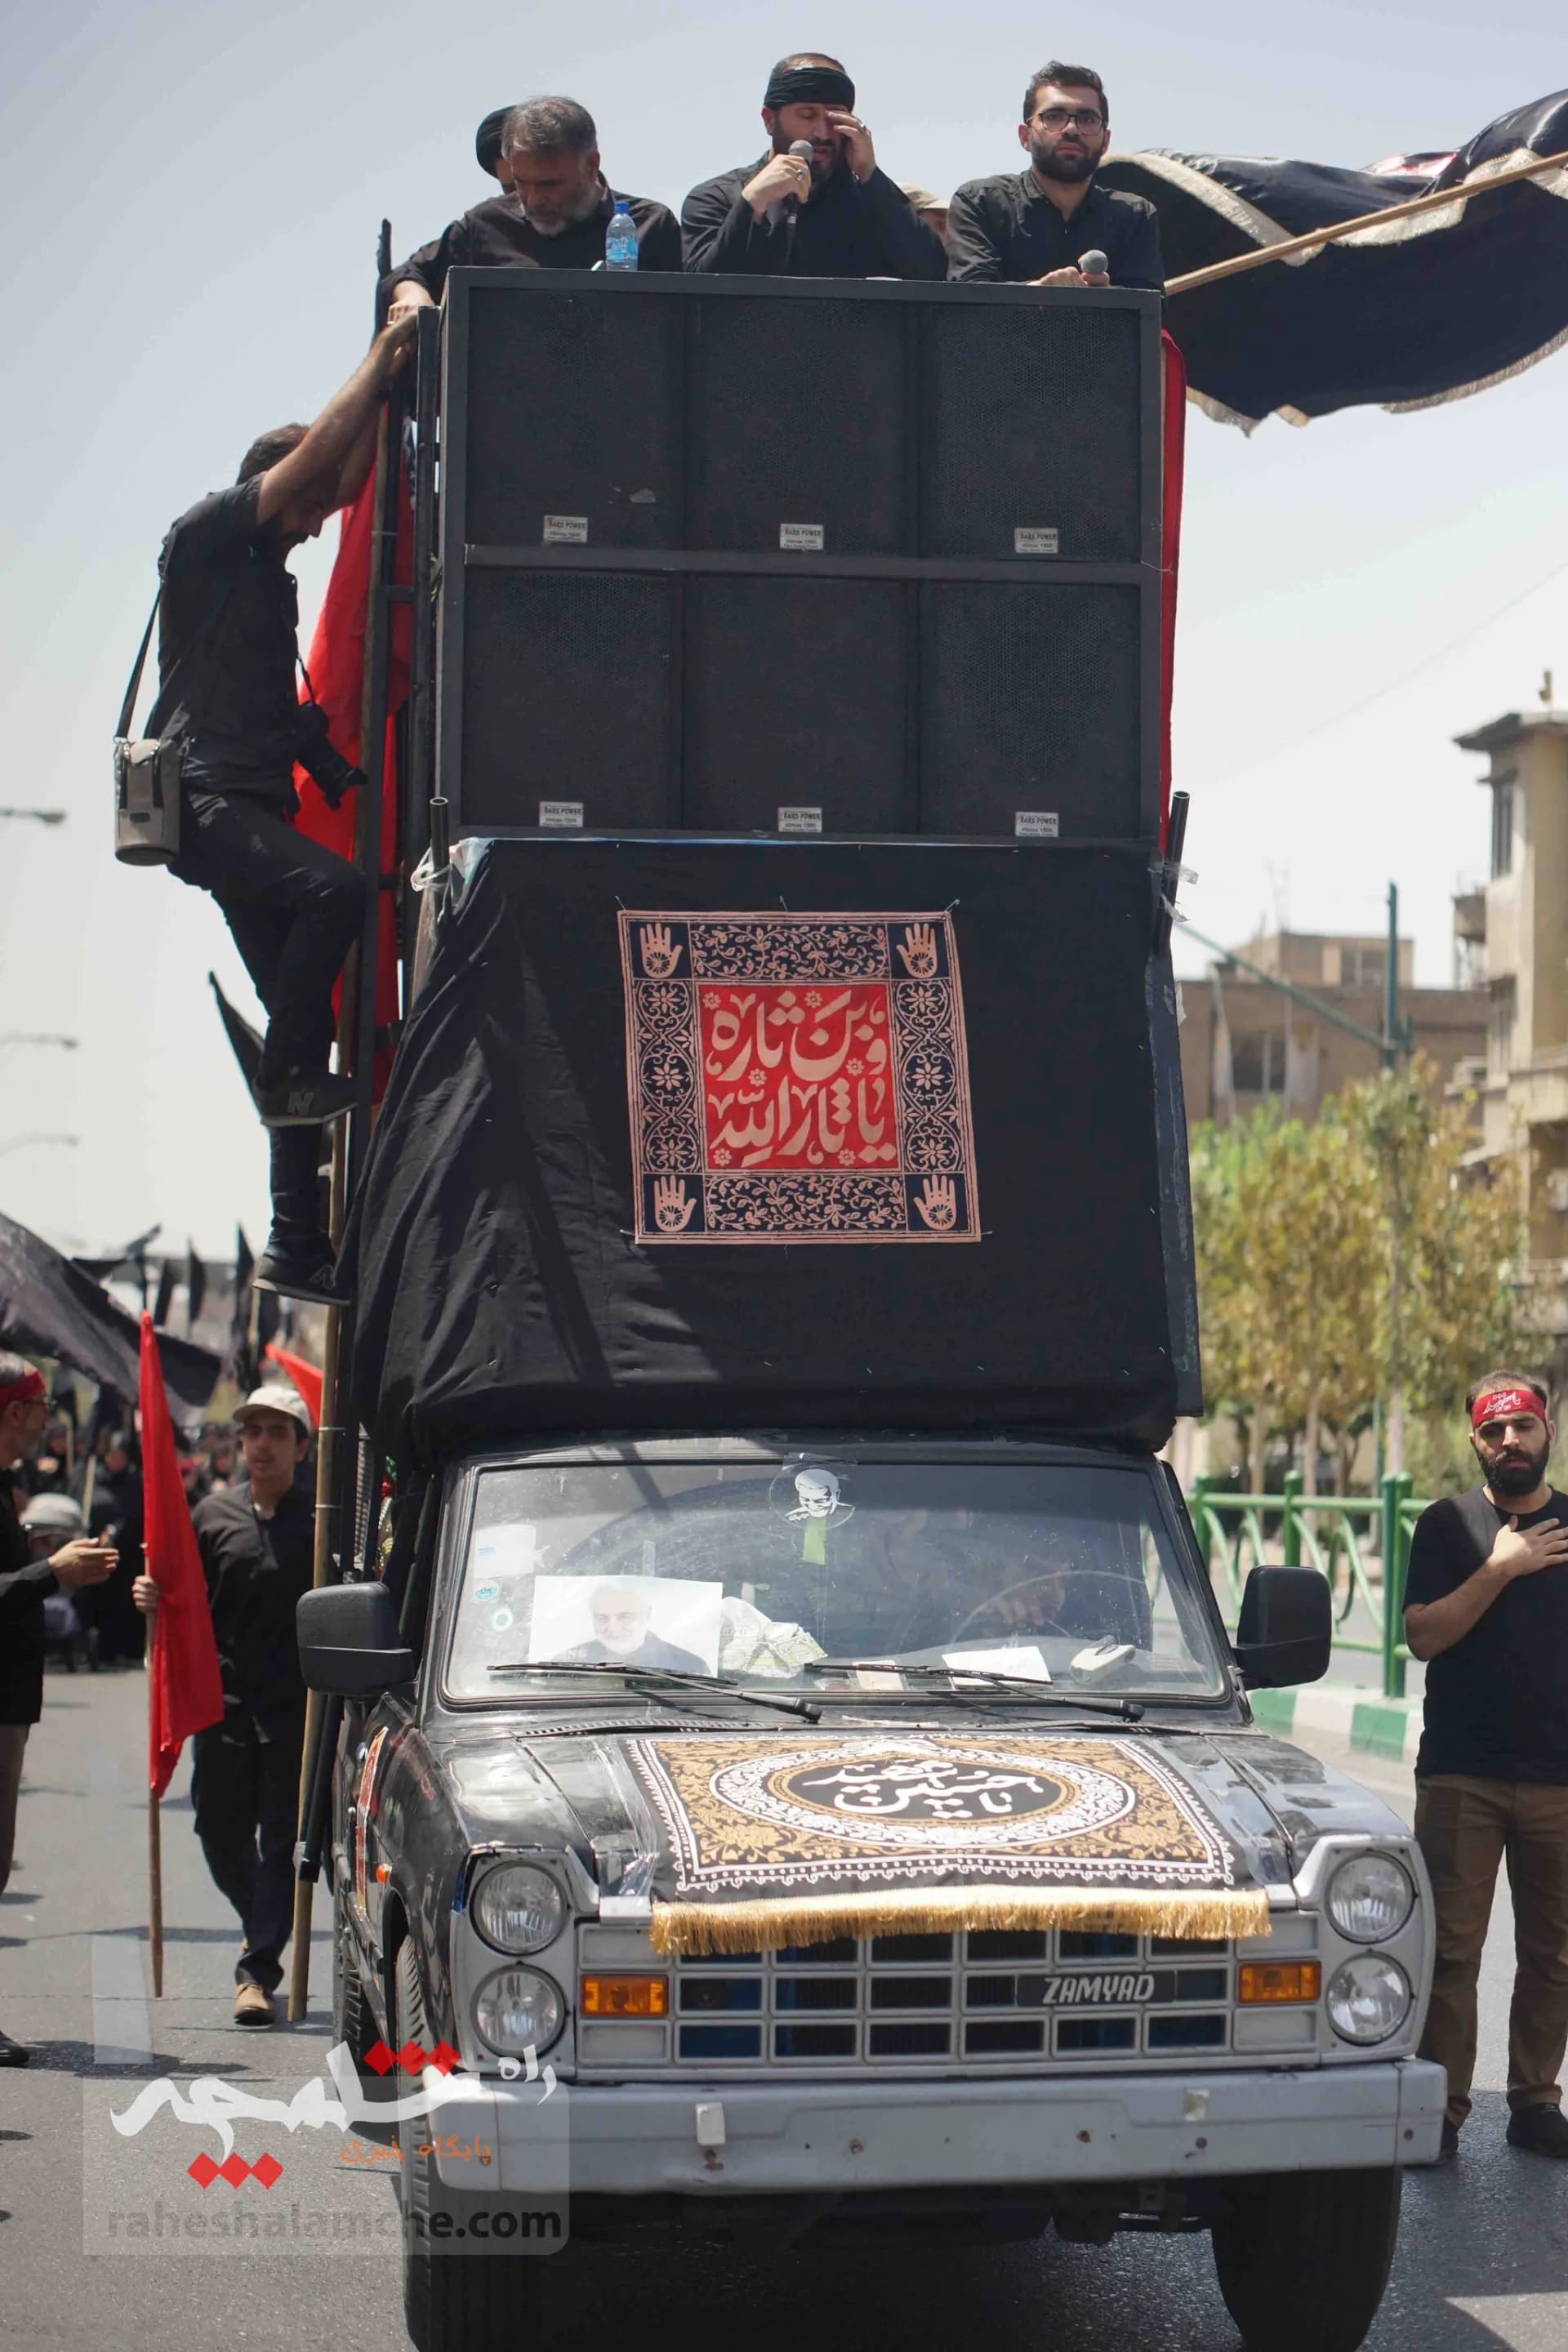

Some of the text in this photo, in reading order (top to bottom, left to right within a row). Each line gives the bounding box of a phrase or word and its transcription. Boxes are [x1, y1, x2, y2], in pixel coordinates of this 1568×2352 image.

[562, 808, 582, 816] POWER
[1036, 817, 1057, 825] POWER
[1042, 1974, 1156, 2005] ZAMYAD
